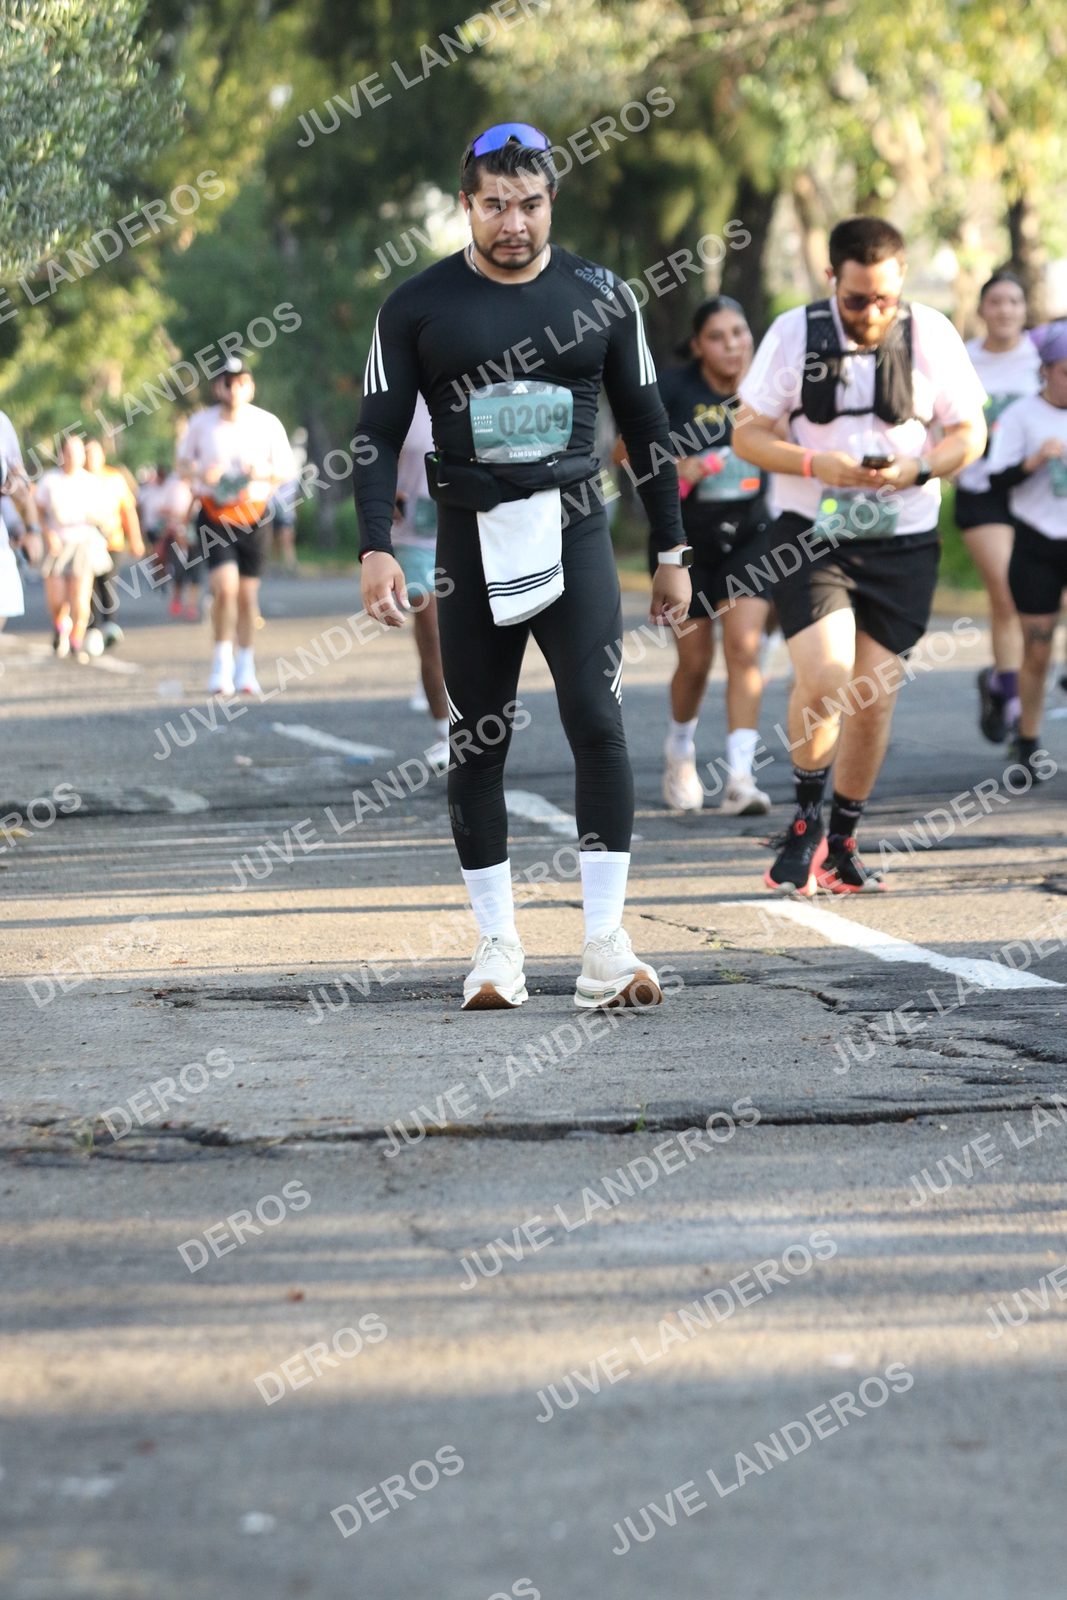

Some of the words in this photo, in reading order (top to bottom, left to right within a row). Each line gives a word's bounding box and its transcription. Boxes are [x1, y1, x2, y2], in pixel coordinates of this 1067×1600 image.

[575, 268, 615, 300] adidas
[498, 403, 569, 436] 0209
[509, 450, 541, 458] SAMSUNG
